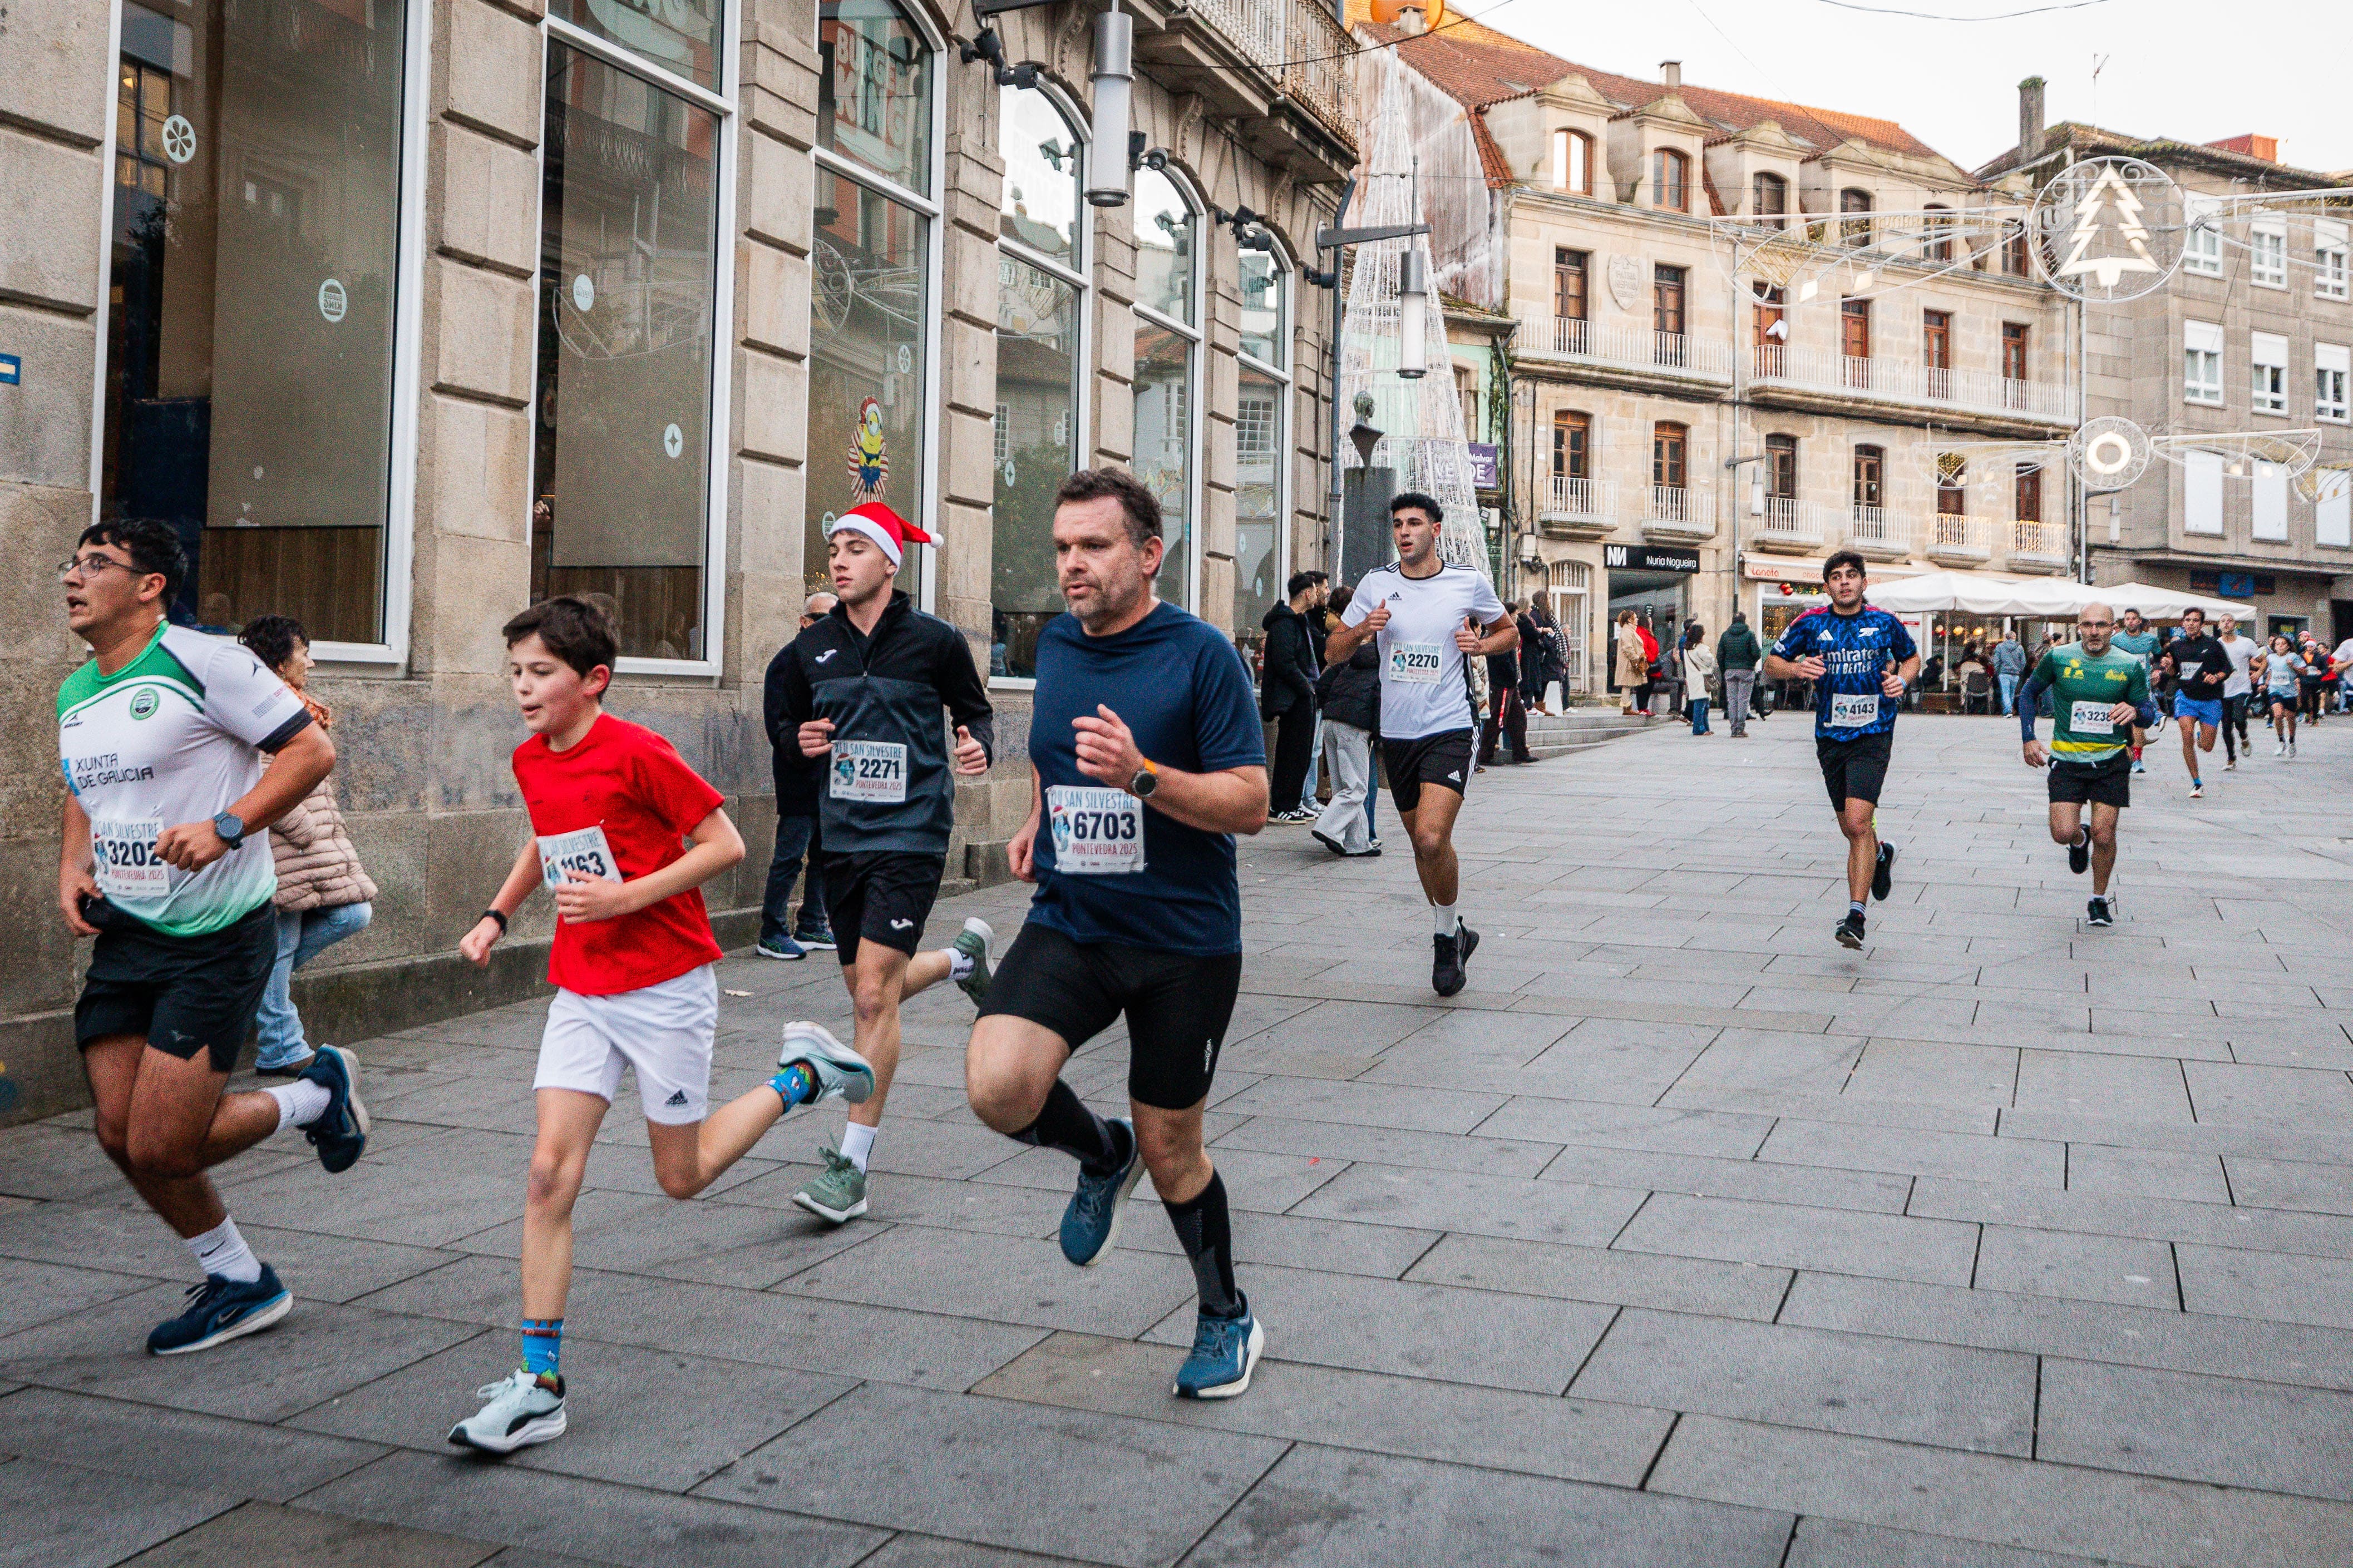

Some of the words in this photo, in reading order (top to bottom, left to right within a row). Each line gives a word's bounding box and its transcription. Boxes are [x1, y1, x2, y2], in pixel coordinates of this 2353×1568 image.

[836, 65, 907, 146] KING
[1646, 555, 1665, 566] Nuria
[1666, 556, 1697, 569] Nogueira
[1403, 644, 1414, 652] SAN
[1414, 645, 1441, 654] SILVESTRE
[1407, 653, 1439, 669] 2270
[1849, 703, 1874, 715] 4143
[850, 743, 865, 755] SAN
[866, 745, 902, 758] SILVESTRE
[76, 753, 119, 773] XUNTA
[859, 758, 900, 779] 2271
[78, 774, 97, 789] DE
[97, 766, 155, 785] GALICIA
[856, 780, 887, 790] PONTEVEDRA
[889, 781, 902, 790] 2025
[1064, 790, 1083, 807] SAN
[1086, 792, 1135, 809] SILVESTRE
[114, 822, 159, 839] SILVESTRE
[1073, 810, 1137, 840] 6703
[108, 840, 163, 867] 3202
[1072, 842, 1117, 855] PONTEVEDRA
[1119, 843, 1138, 855] 2025
[561, 851, 608, 883] 1163
